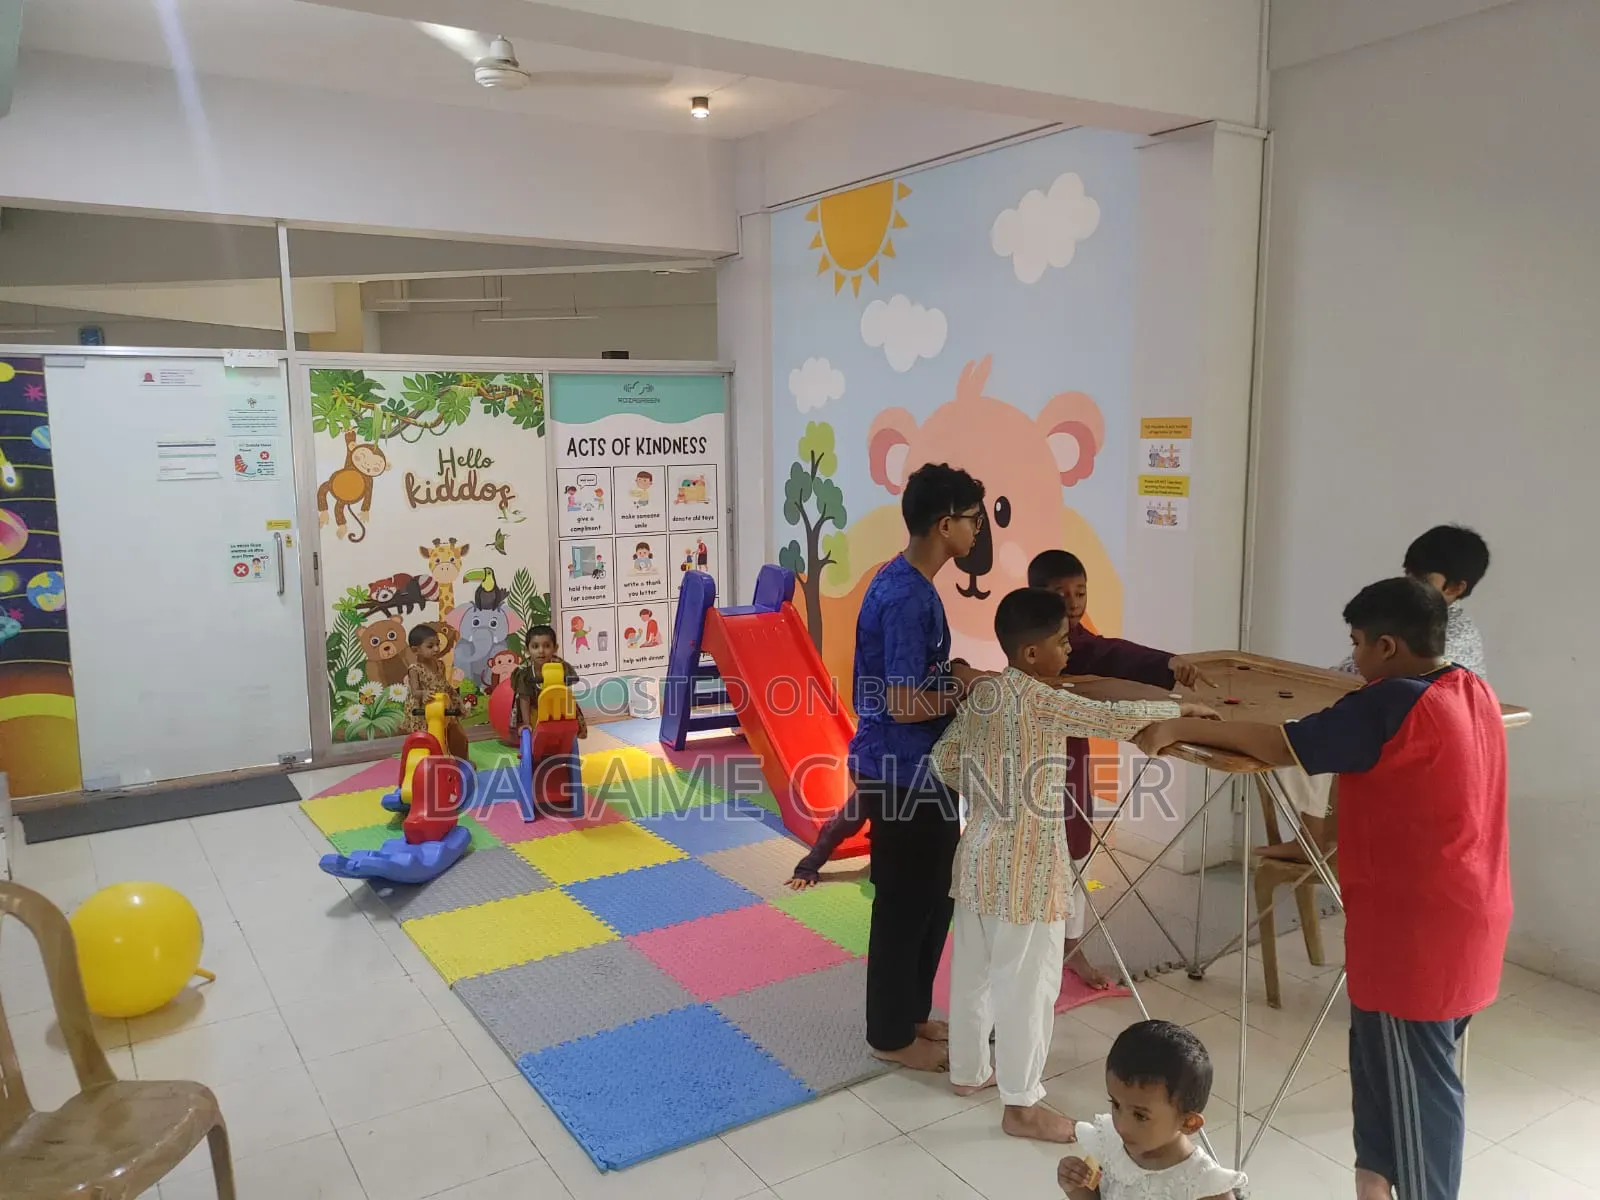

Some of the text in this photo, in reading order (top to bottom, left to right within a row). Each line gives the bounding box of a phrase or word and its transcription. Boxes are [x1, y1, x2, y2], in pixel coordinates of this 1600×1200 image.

[566, 436, 707, 457] ACTS OF KINDNESS
[437, 447, 495, 478] Hello
[405, 467, 516, 511] kiddos
[570, 525, 601, 533] compliment
[623, 657, 634, 665] help
